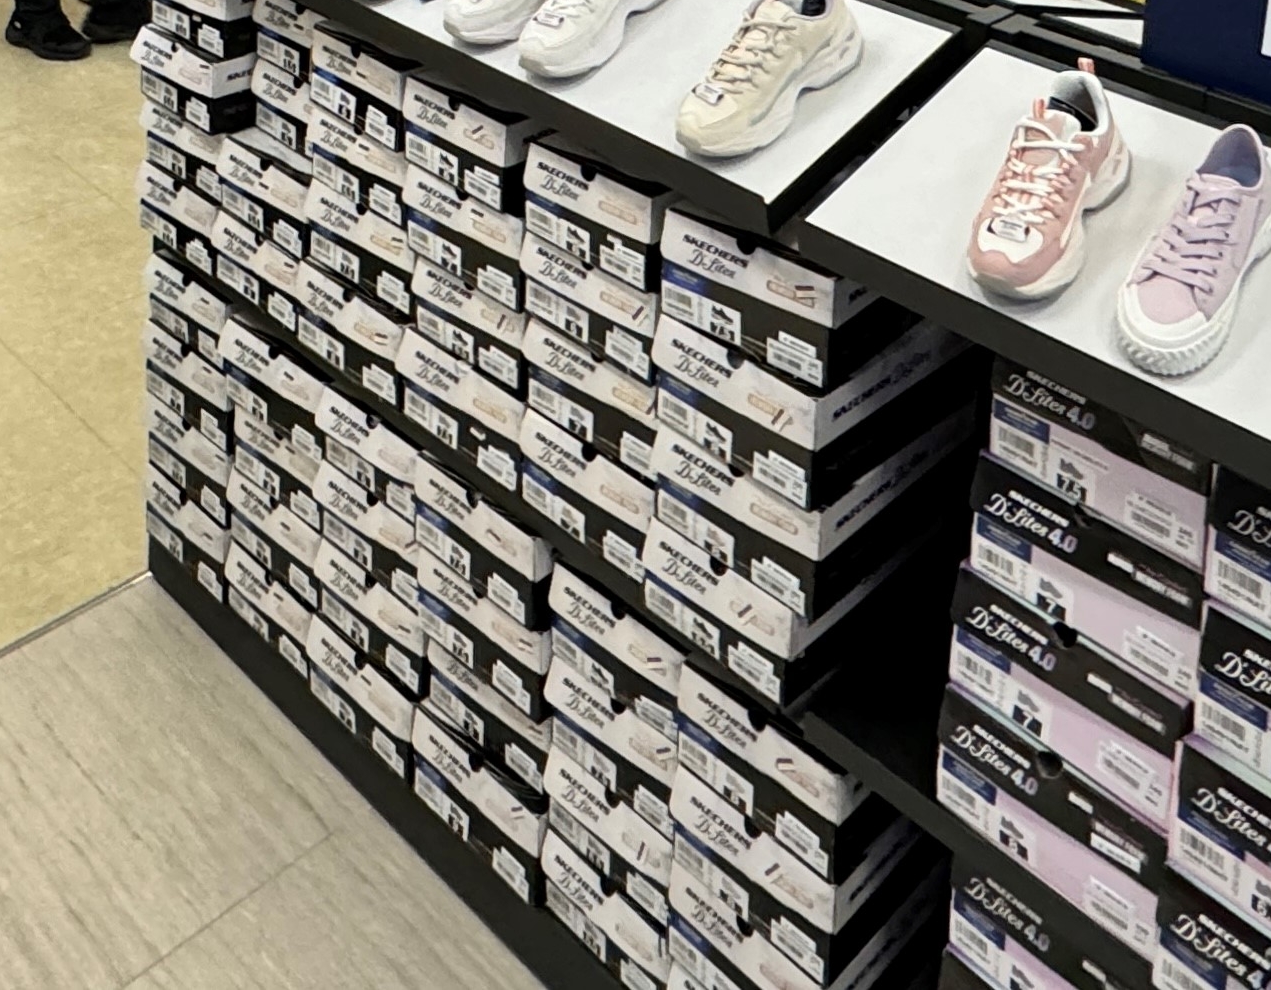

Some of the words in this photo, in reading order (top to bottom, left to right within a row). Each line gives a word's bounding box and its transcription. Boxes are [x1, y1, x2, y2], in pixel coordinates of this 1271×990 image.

[537, 161, 589, 191] SKECHERS
[536, 246, 588, 279] SKECHERS
[682, 233, 749, 269] SKECHERS
[543, 337, 596, 372] SKECHERS
[671, 338, 733, 379] SKECHERS
[1003, 373, 1066, 417] D'Lites
[1026, 370, 1087, 405] SKECHERS
[534, 431, 587, 471] SKECHERS
[671, 443, 736, 487] SKECHERS
[984, 493, 1047, 537] D'Lites
[1008, 490, 1070, 528] SKECHERS
[658, 540, 719, 587] SKECHERS
[562, 586, 617, 629] SKECHERS
[990, 604, 1049, 645] SKECHERS
[965, 607, 1027, 654] D'Lites
[561, 677, 616, 722] SKECHERS
[697, 692, 758, 743] SKECHERS
[950, 725, 1010, 777] D'Lites
[972, 724, 1031, 770] SKECHERS
[559, 768, 611, 816] SKECHERS
[690, 796, 752, 850] SKECHERS
[1190, 787, 1267, 847] D'Lites
[1169, 914, 1248, 978] D'Lites
[1198, 914, 1271, 971] SKECHERS
